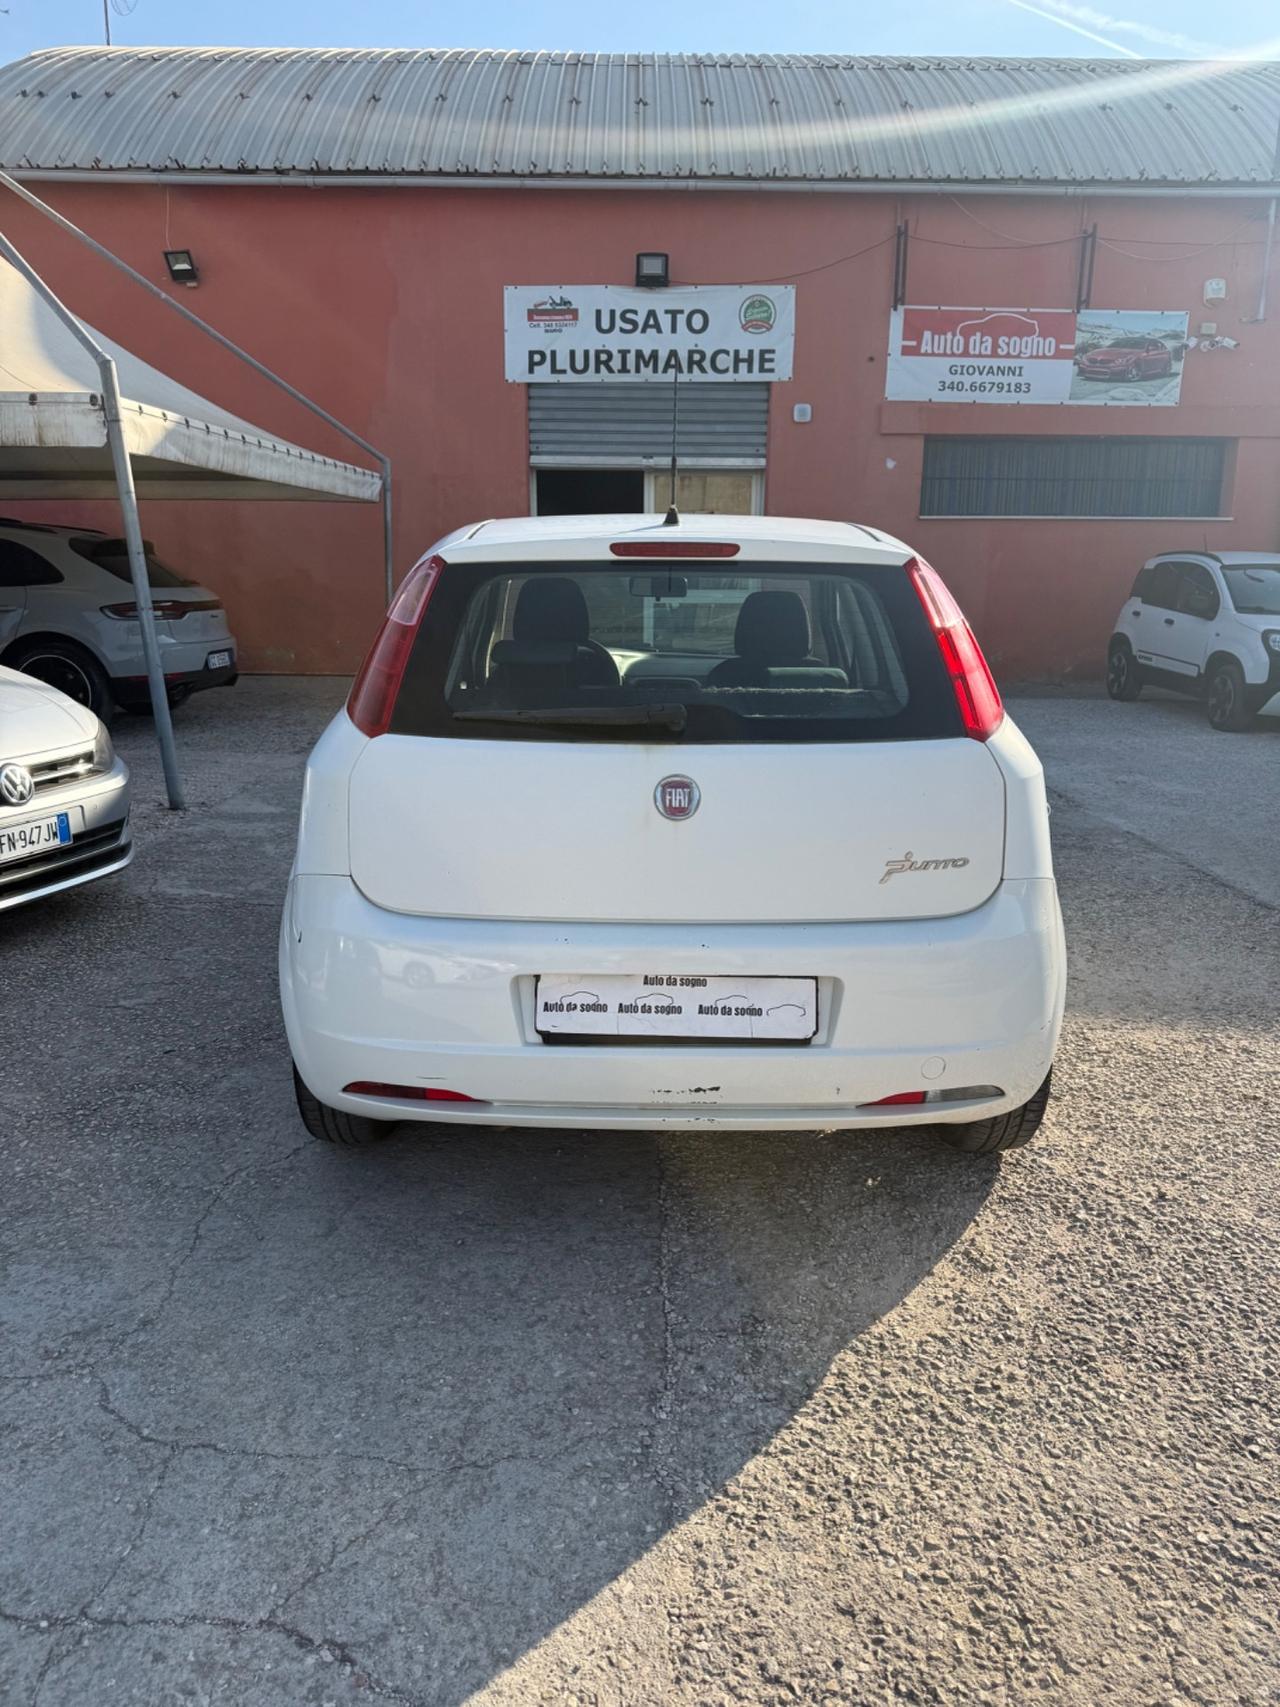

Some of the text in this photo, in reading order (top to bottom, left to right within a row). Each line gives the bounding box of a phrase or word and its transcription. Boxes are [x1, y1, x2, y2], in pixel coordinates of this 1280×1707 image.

[595, 309, 709, 334] USATO
[920, 330, 1056, 357] Auto da sogno
[527, 349, 776, 374] PLURIMARCHE
[948, 364, 1024, 377] GIOVANNI
[938, 380, 1031, 394] 340.6679183
[665, 788, 691, 807] FIAT
[643, 975, 707, 987] Auto da sogno
[543, 1001, 564, 1013] Auto
[618, 1003, 682, 1015] Auto da sogno
[698, 1004, 718, 1016] Auto
[721, 1005, 732, 1016] da
